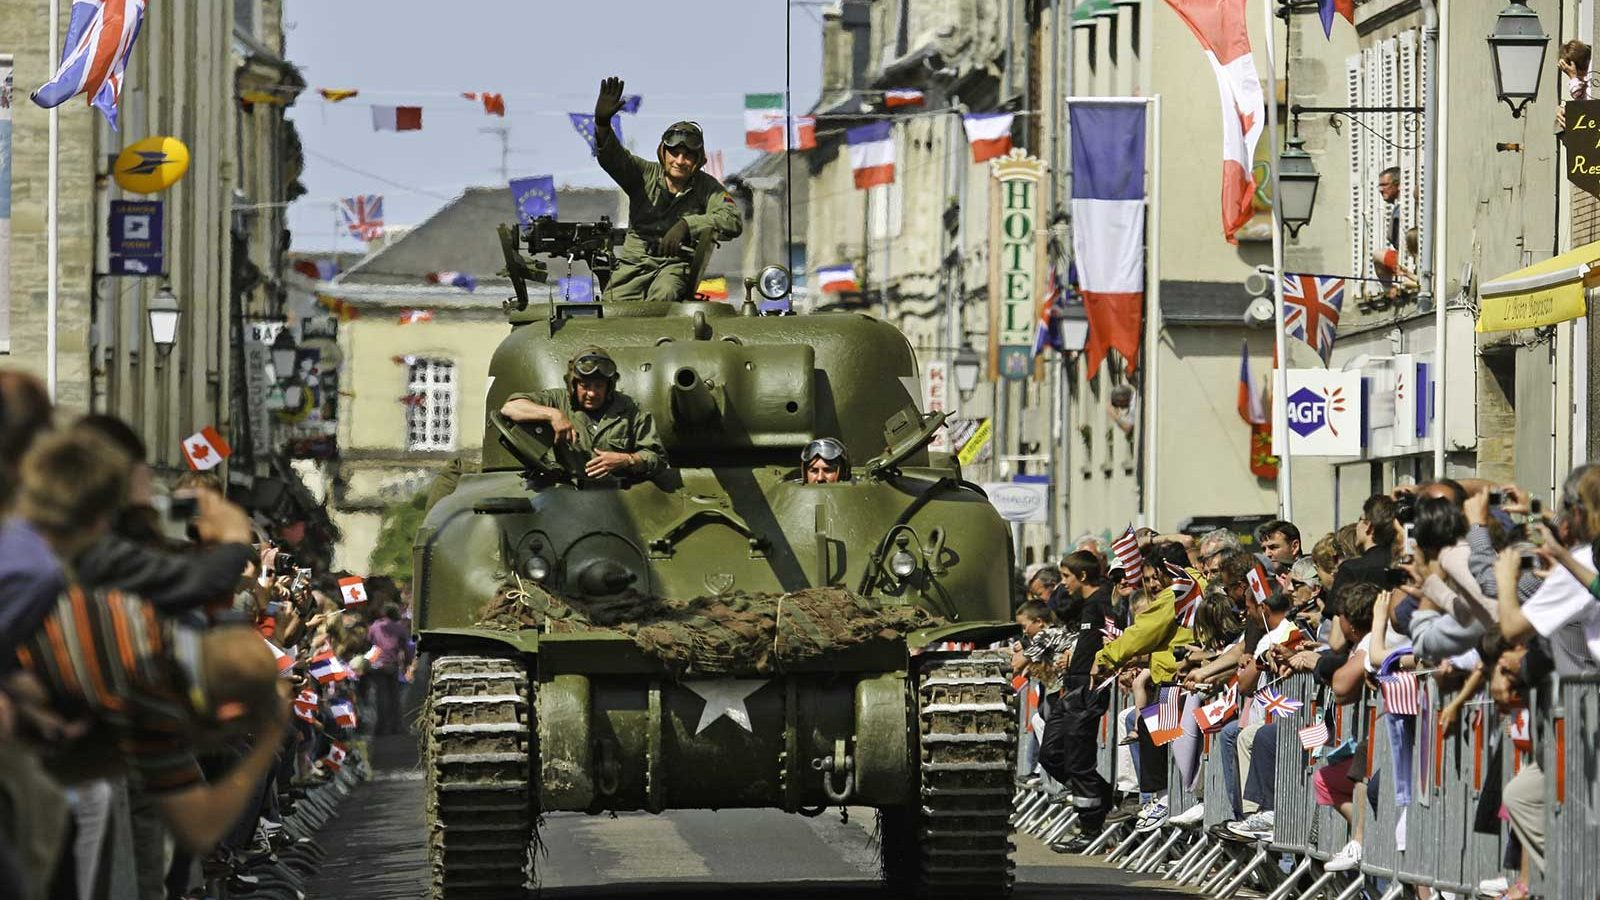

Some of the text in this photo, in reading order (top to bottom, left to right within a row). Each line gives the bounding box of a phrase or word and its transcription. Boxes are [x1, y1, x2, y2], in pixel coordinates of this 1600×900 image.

[1572, 114, 1597, 131] Le
[1004, 180, 1032, 331] HOTEL
[1288, 402, 1326, 424] AGF
